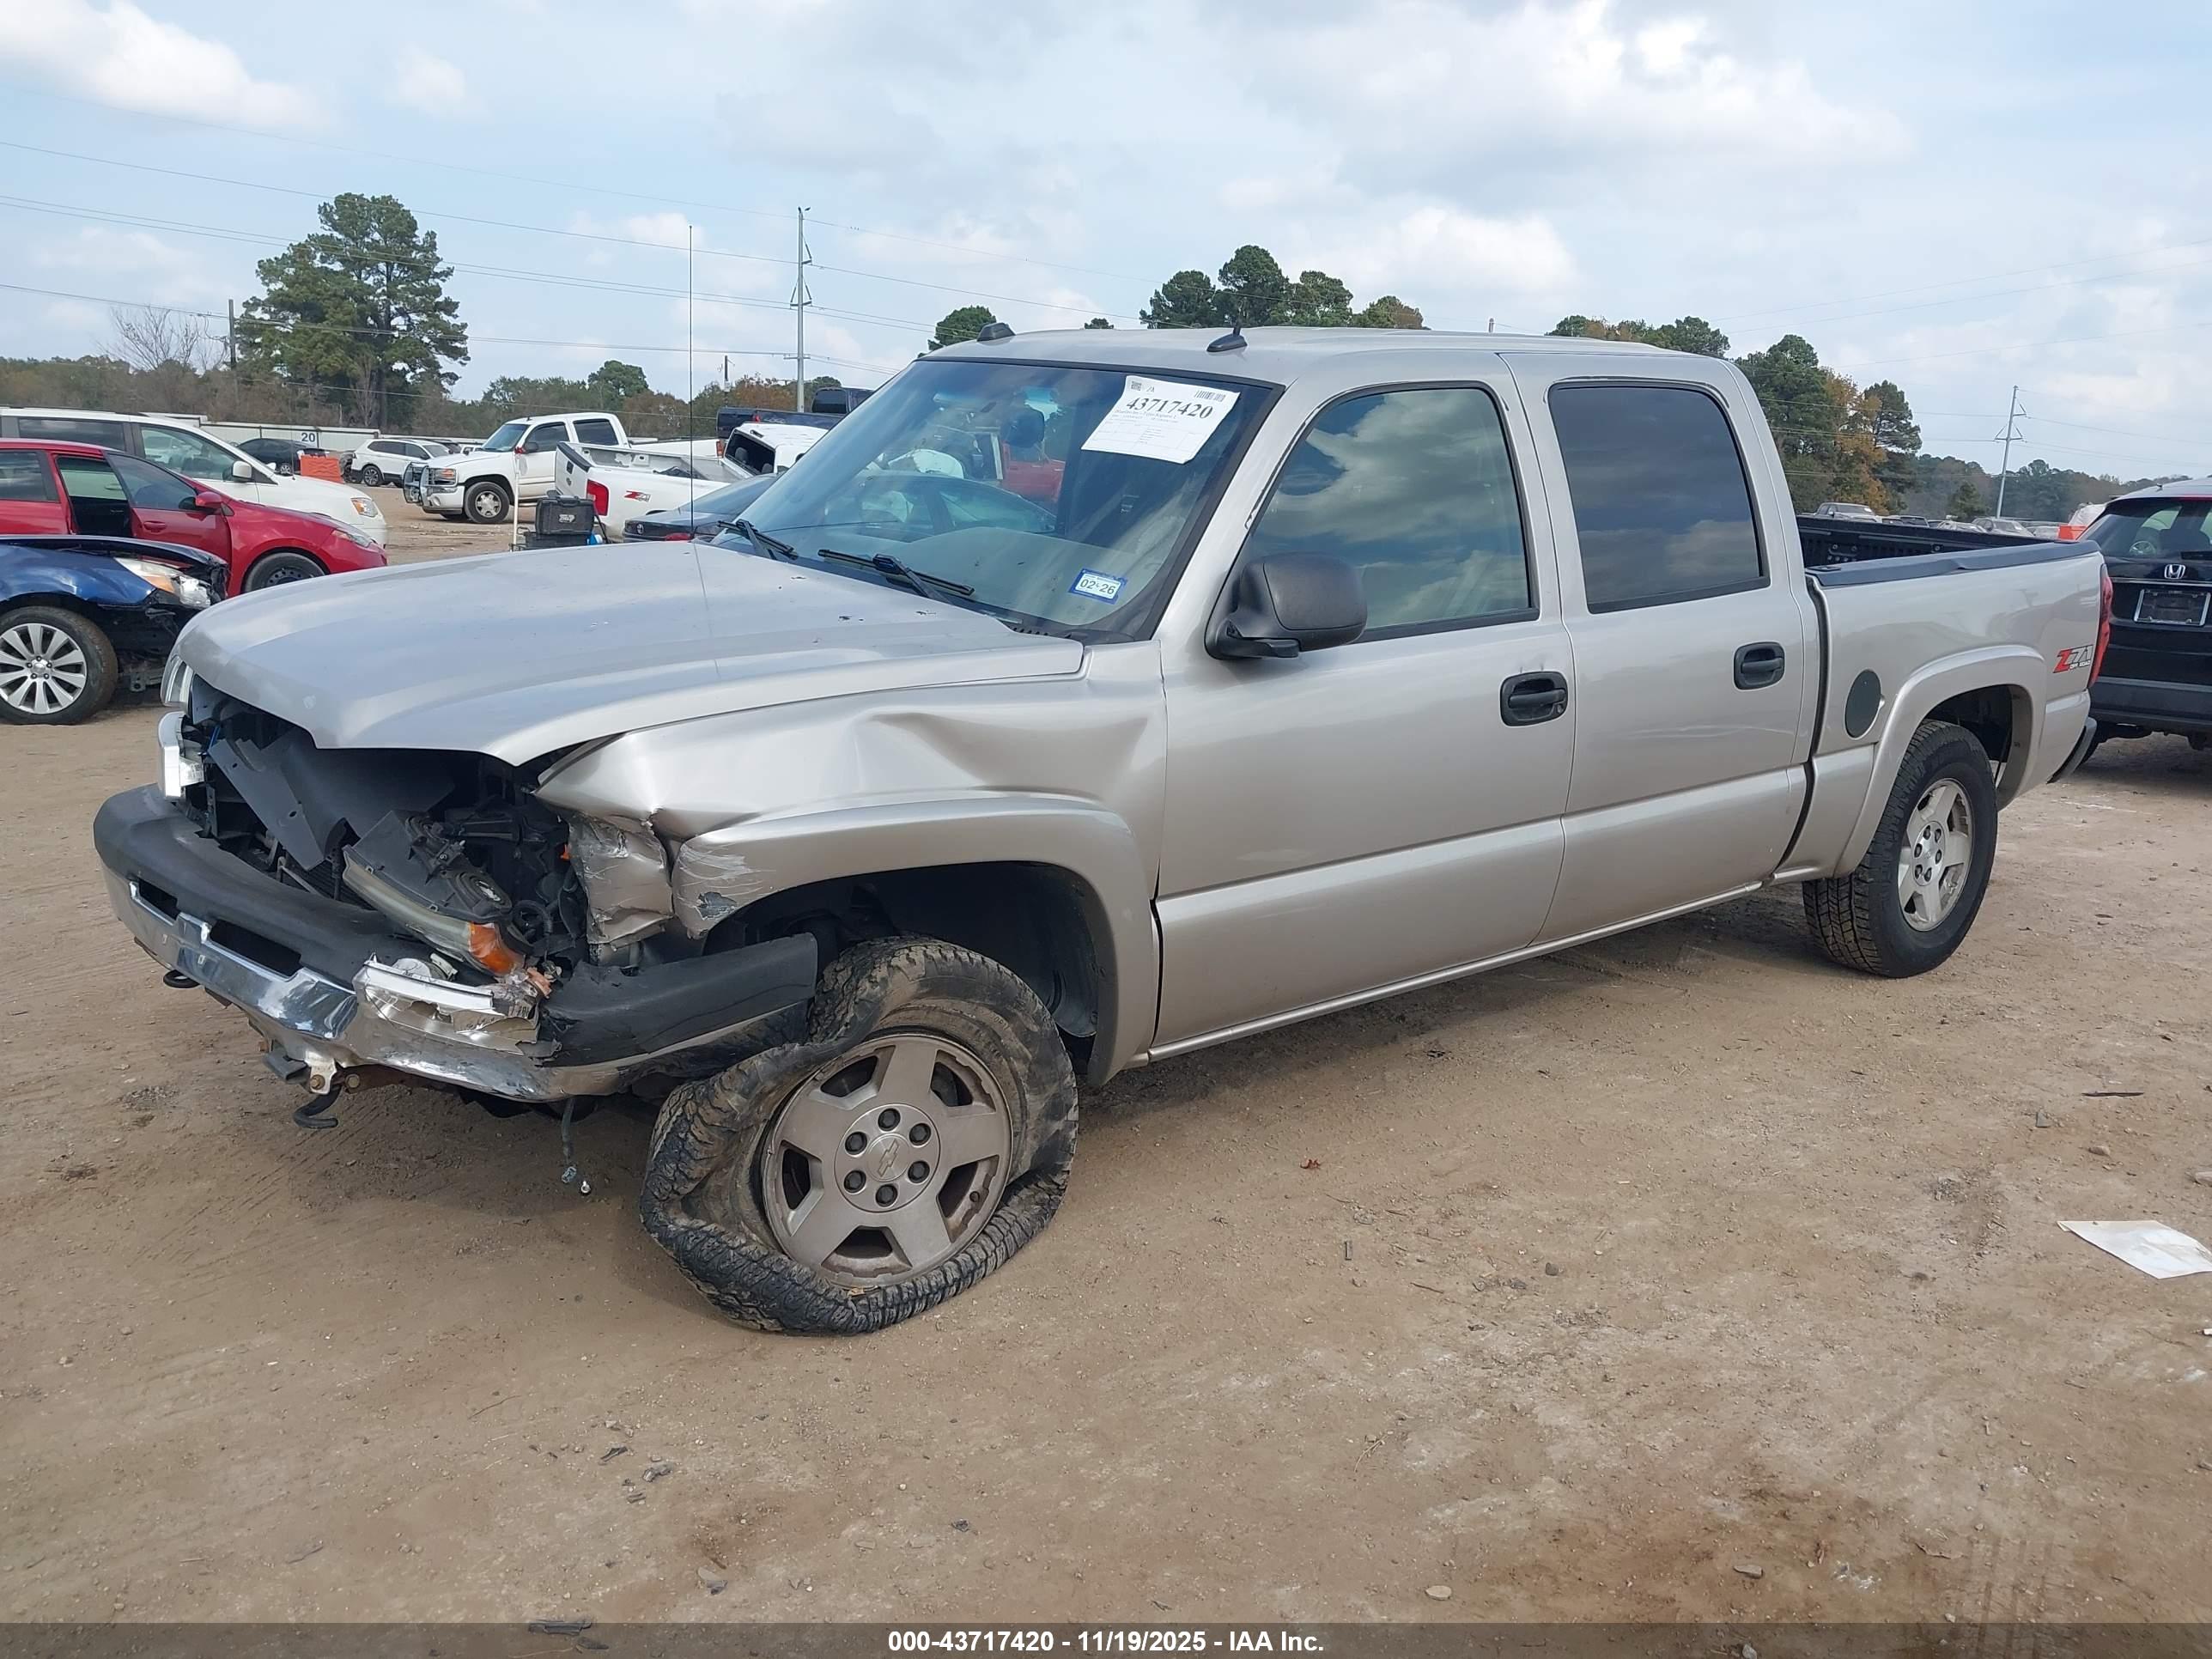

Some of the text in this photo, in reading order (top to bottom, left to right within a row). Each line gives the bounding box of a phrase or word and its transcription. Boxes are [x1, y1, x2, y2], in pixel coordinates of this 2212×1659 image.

[1126, 397, 1213, 419] 43717420
[301, 432, 316, 442] 20
[2052, 644, 2094, 674] Z71
